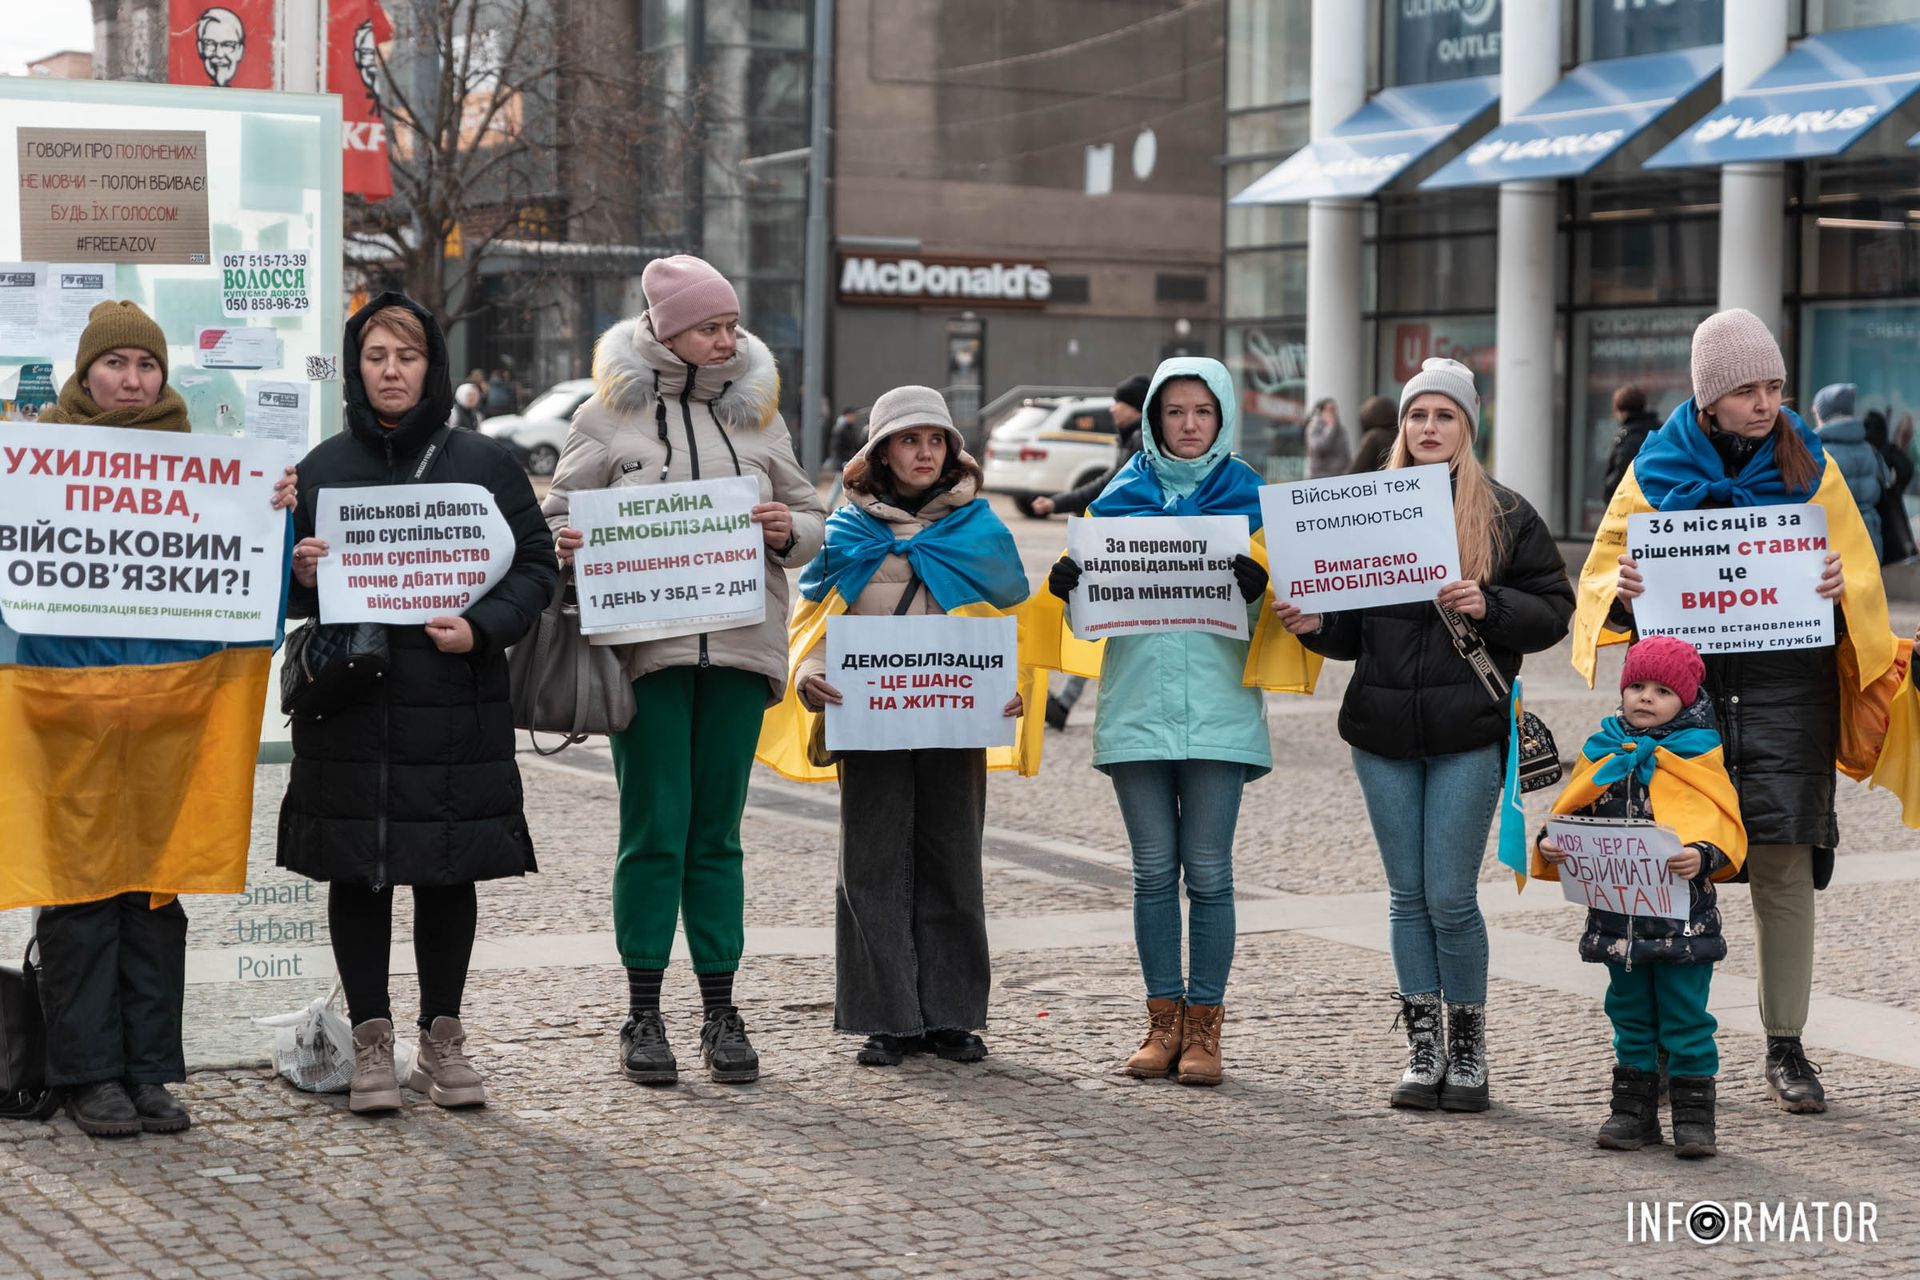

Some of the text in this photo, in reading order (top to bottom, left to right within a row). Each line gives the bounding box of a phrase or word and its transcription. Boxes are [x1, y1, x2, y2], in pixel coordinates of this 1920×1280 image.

[1735, 105, 1879, 139] VARUS
[343, 121, 387, 150] KF
[27, 142, 197, 160] ГОВОРИ ПРО ПОЛОНЕНИХ!
[20, 174, 38, 189] НЕ
[42, 174, 86, 189] МОВЧИ
[101, 175, 146, 190] ПОЛОН
[150, 176, 206, 191] ВБИВАЄ!
[50, 201, 178, 222] БУДЬ ЇХ ГОЛОСОМ!
[77, 237, 156, 252] #FREEAZOV
[223, 254, 307, 267] 067 515-73-39
[223, 268, 305, 289] ВОЛОССЯ
[840, 257, 1051, 298] McDonald's
[224, 289, 306, 299] купуємо дорого
[226, 297, 309, 311] 050 858-96-29
[3, 447, 241, 486] УХИЛЯНТАМ
[1291, 478, 1421, 505] Військові теж
[65, 484, 200, 523] ПРАВА,
[339, 501, 489, 522] Військові дбають
[618, 493, 713, 518] НЕГАЙНА
[589, 513, 751, 547] ДЕМОБІЛІЗАЦІЯ
[1296, 506, 1423, 533] втомлюються
[1649, 514, 1801, 534] 36 місяців за
[0, 519, 241, 562] ВІЙСЬКОВИМ
[345, 524, 486, 545] про суспільство,
[341, 547, 490, 567] коли суспільство
[1105, 538, 1208, 555] За перемогу
[1632, 536, 1827, 561] рішенням ставки
[583, 548, 757, 577] БЕЗ РІШЕННЯ СТАВКИ
[1084, 557, 1232, 574] відповідальні всі
[1314, 552, 1418, 574] Вимагаємо
[347, 571, 486, 590] почне дбати про
[1290, 565, 1447, 598] ДЕМОБІЛІЗАЦІЮ
[1719, 566, 1747, 582] це
[367, 592, 470, 610] військових?
[590, 579, 757, 609] 1 ДЕНЬ У ЗБД = 2 ДНІ
[1088, 584, 1232, 603] Пора мінятися!
[1681, 587, 1778, 614] вирок
[2, 599, 261, 620] ЕГАЙНА ДЕМОБІЛІЗАЦІЯ БЕЗ РІШЕННЯ СТАВКИ!
[1140, 619, 1161, 627] через
[1642, 619, 1821, 636] вимагаємо встановлення
[1708, 639, 1764, 651] терміну
[1769, 634, 1822, 647] служби
[842, 652, 1004, 671] ДЕМОБІЛІЗАЦІЯ
[1474, 654, 1492, 676] DIOR
[880, 674, 907, 692] ЦЕ
[912, 673, 973, 689] ШАНС
[869, 694, 975, 710] НА ЖИТТЯ
[1556, 833, 1648, 857] МОЯ ЧЕРГА
[1564, 854, 1674, 886] ОБІЙМАТИ
[237, 880, 314, 906] Smart
[1577, 880, 1672, 917] ТАТА!!!
[237, 917, 314, 943] Urban
[238, 953, 302, 979] Point
